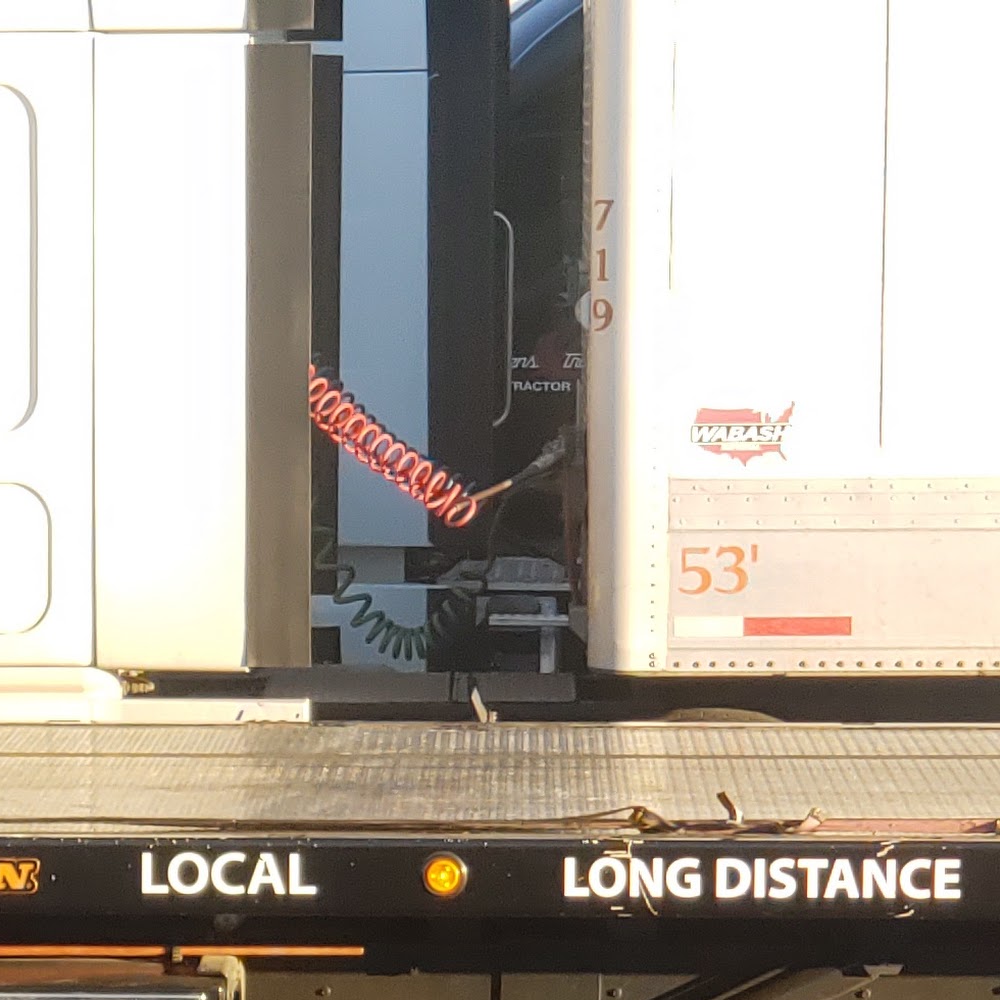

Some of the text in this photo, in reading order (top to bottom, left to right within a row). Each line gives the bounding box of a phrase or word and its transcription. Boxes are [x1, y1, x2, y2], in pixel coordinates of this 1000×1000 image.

[691, 425, 786, 443] WABASH
[678, 544, 758, 595] 53'
[141, 852, 318, 895] LOCAL
[562, 857, 962, 899] LONG DISTANCE
